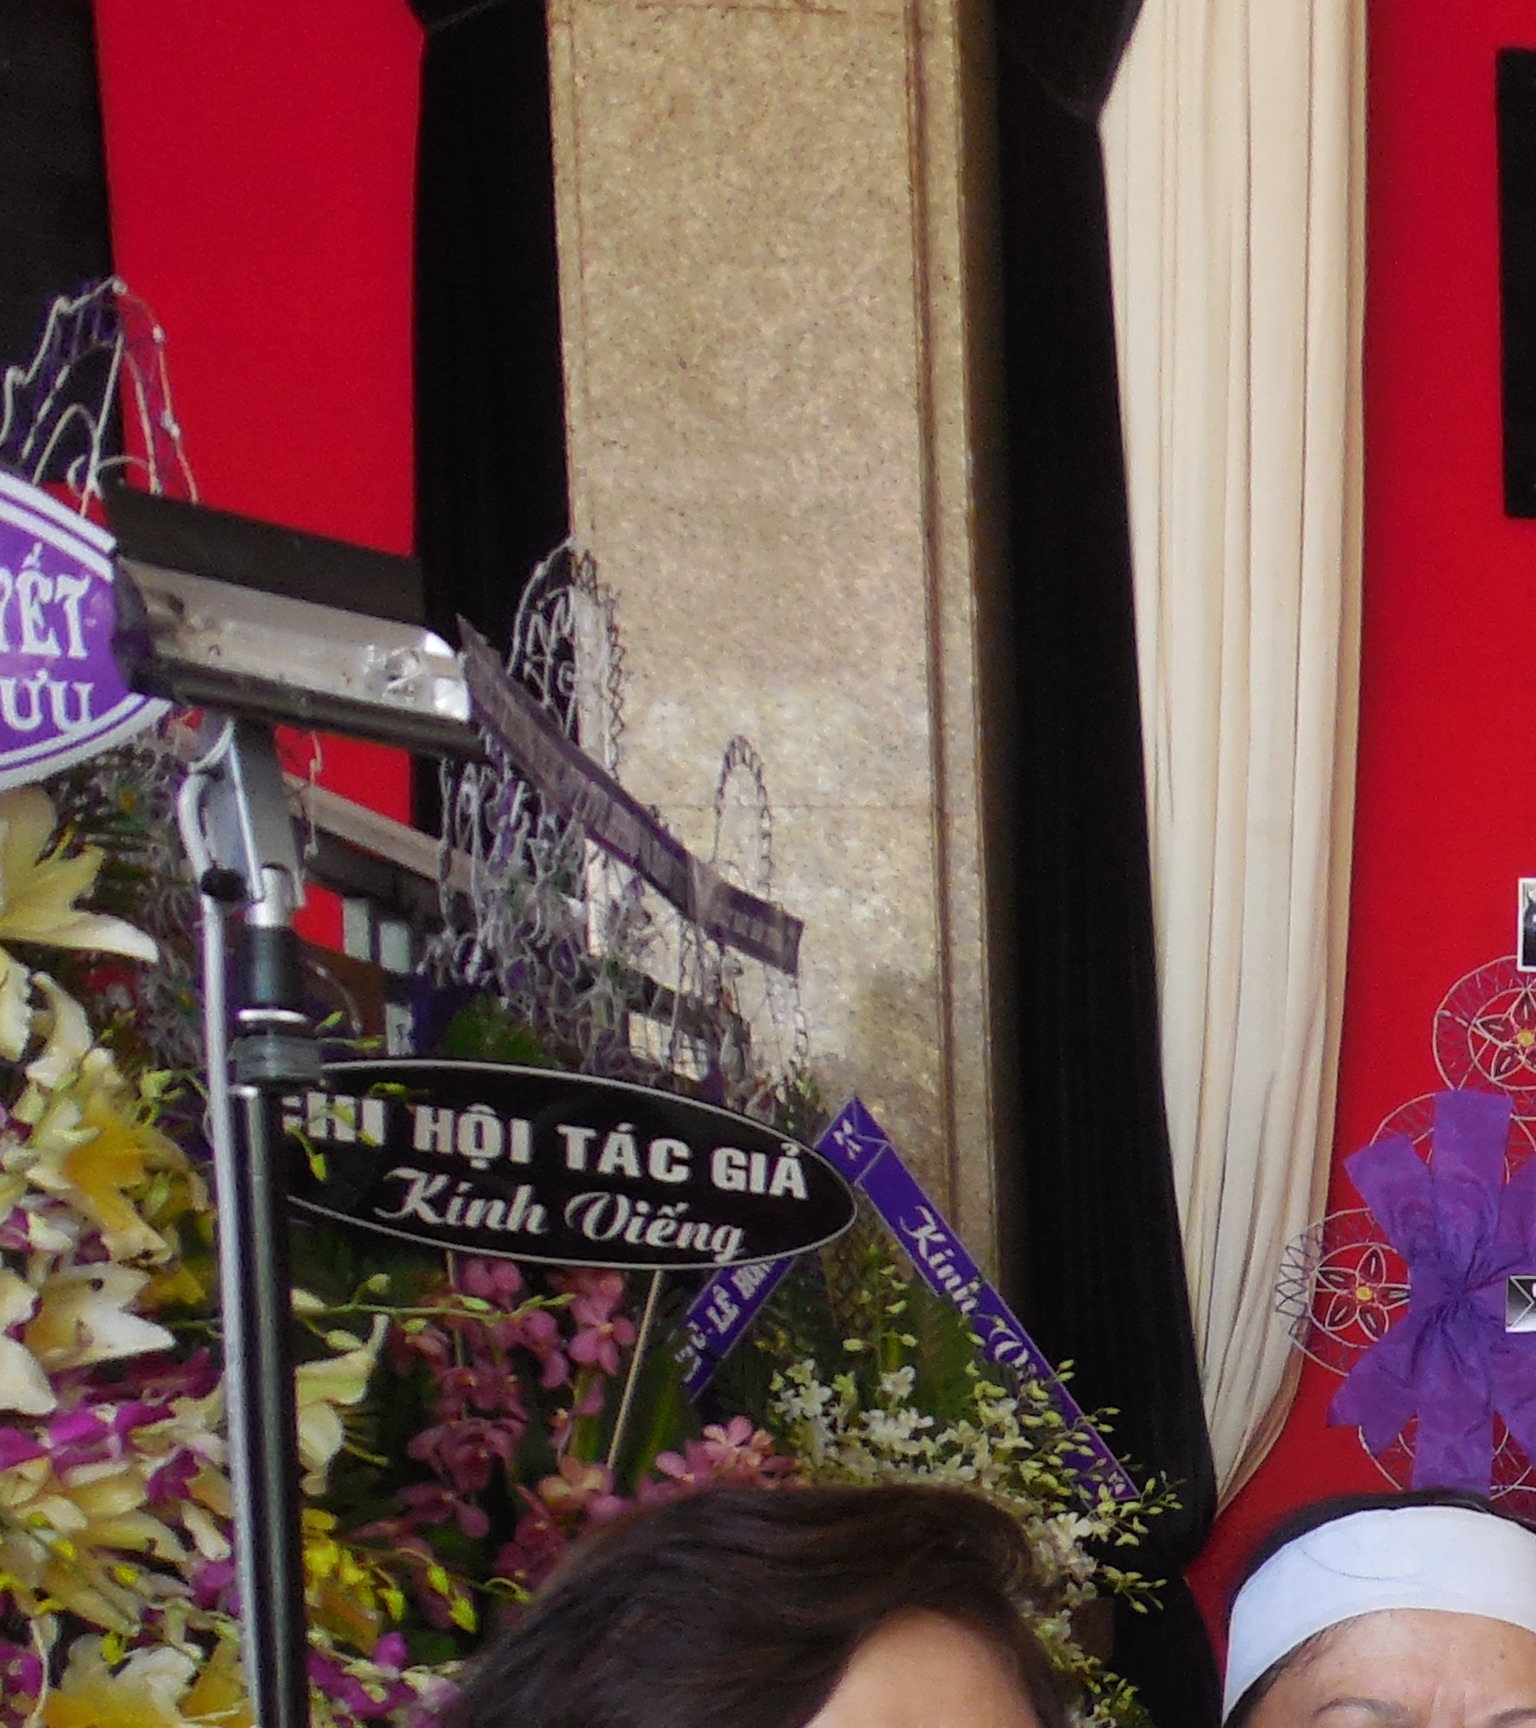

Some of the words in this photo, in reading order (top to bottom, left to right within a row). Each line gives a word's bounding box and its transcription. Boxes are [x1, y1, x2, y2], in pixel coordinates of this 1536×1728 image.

[413, 1103, 532, 1170] HỘI
[557, 1122, 694, 1184] TÁC
[711, 1141, 808, 1200] GIẢ
[373, 1167, 550, 1237] Kính
[564, 1191, 746, 1263] Viếng
